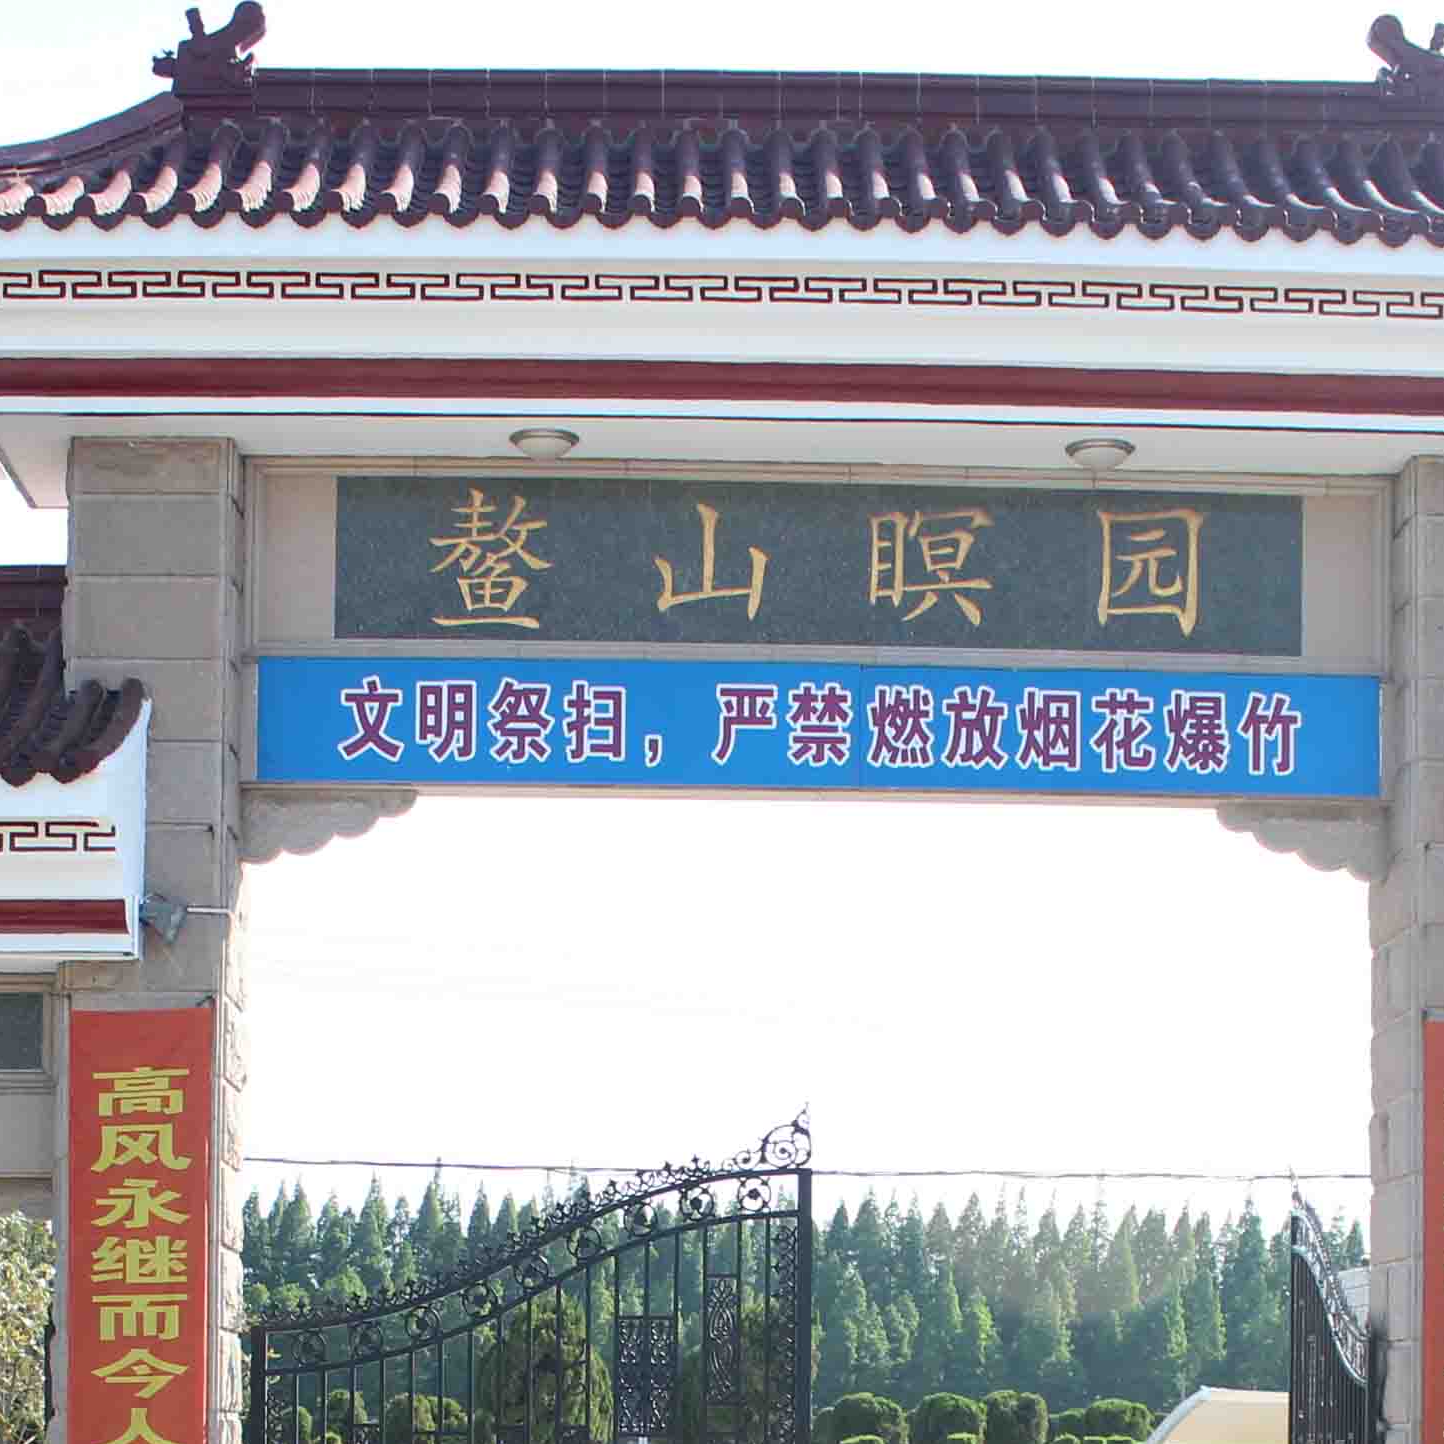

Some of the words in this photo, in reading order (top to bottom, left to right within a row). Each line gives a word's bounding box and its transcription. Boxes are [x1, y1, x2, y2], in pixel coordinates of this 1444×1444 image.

[338, 675, 1303, 777] 文明祭扫，严禁燃放烟花爆竹
